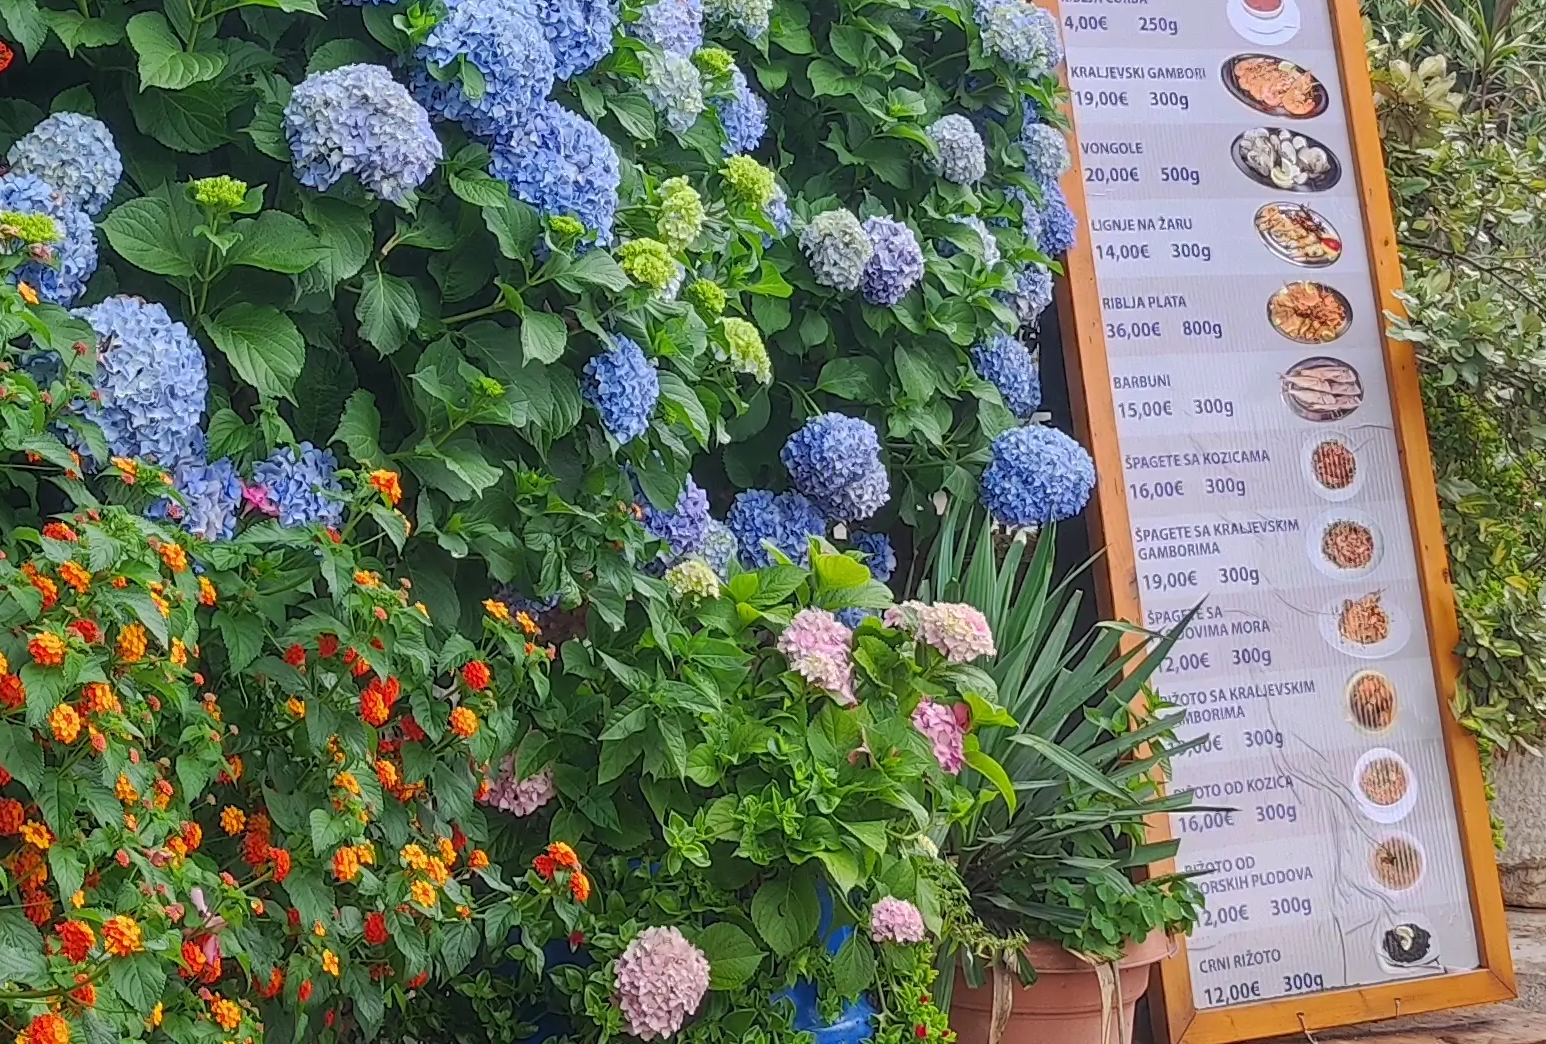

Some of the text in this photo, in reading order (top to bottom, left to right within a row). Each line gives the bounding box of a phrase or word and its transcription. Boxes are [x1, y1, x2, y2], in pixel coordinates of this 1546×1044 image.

[1064, 15, 1178, 35] 4,00€ 250g
[1071, 67, 1206, 79] KRALJEVSKI GAMBORI
[1075, 91, 1189, 109] 19,00€ 300g
[1081, 142, 1143, 154] VONGOLE
[1084, 167, 1200, 185] 20,00€ 500g
[1091, 216, 1192, 232] LIGNJE NA ŽARU
[1096, 244, 1211, 260] 14,00€ 300g
[1103, 296, 1187, 309] RIBLJA PLATA
[1107, 321, 1222, 339] 36,00€ 800g
[1113, 374, 1171, 389] BARBUNI
[1118, 398, 1234, 420] 15,00€ 300g
[1125, 449, 1270, 470] ŠPAGETE SA KOZICAMA
[1130, 478, 1246, 500] 16,00€ 300g
[1135, 519, 1300, 542] ŠPAGETE SA KRALJEVSKIM
[1138, 542, 1221, 561] GAMBORIMA
[1142, 567, 1260, 592] 19,00€ 300g
[1206, 607, 1223, 620] SA
[1232, 620, 1271, 636] MORA
[1158, 648, 1272, 674] 2,00€ 300g
[1210, 688, 1227, 703] SA
[1229, 681, 1315, 701] KRALJEVSKIM
[1244, 729, 1284, 748] 300g
[1225, 780, 1243, 795] OD
[1178, 804, 1297, 832] 16,00€ 300g
[1236, 856, 1255, 870] OD
[1195, 867, 1313, 894] ORSKIH PLODOVA
[1270, 897, 1311, 915] 300g
[1199, 948, 1281, 975] CRNI RIŽOTO
[1204, 972, 1323, 1006] 12,00€ 300g
